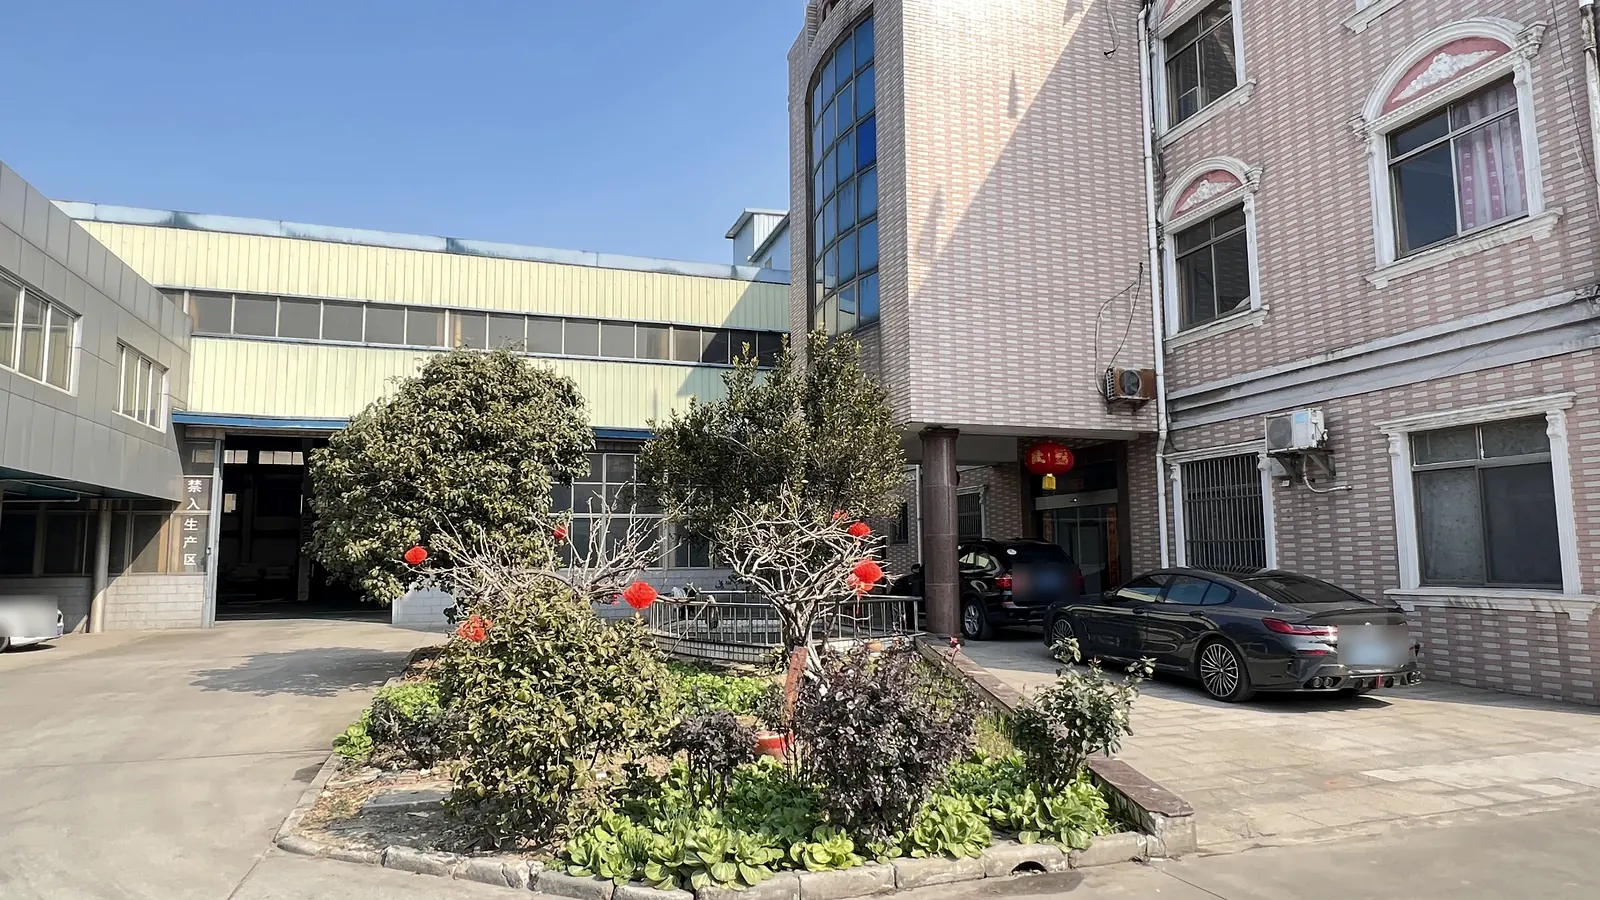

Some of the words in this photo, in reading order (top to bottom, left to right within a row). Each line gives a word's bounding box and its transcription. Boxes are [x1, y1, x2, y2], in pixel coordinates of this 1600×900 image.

[183, 479, 202, 566] 禁入生产区
